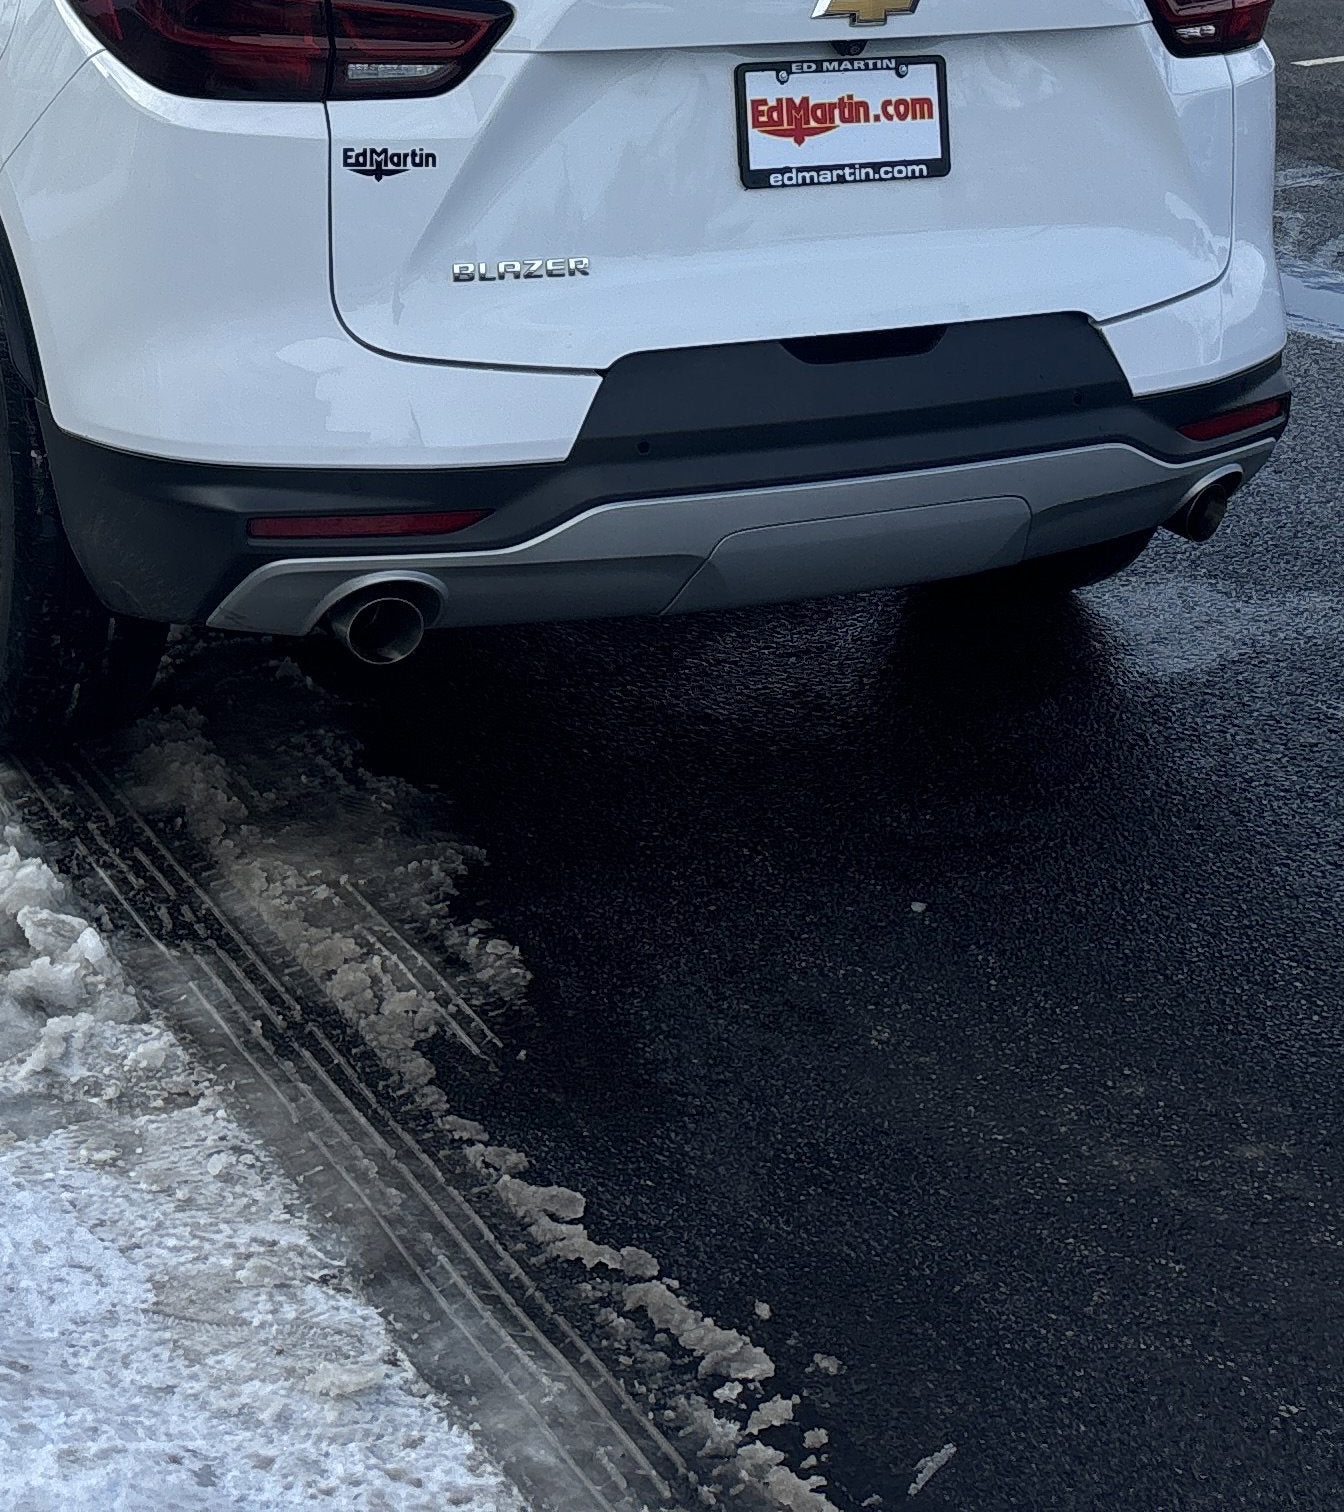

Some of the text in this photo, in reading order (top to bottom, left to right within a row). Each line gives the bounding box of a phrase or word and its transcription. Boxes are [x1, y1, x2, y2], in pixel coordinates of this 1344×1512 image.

[791, 58, 896, 72] ED MARTIN
[750, 94, 934, 129] EdMartin.com
[342, 147, 436, 168] EdMartin
[769, 164, 928, 186] edmartin.com
[452, 257, 590, 282] BLAZER
